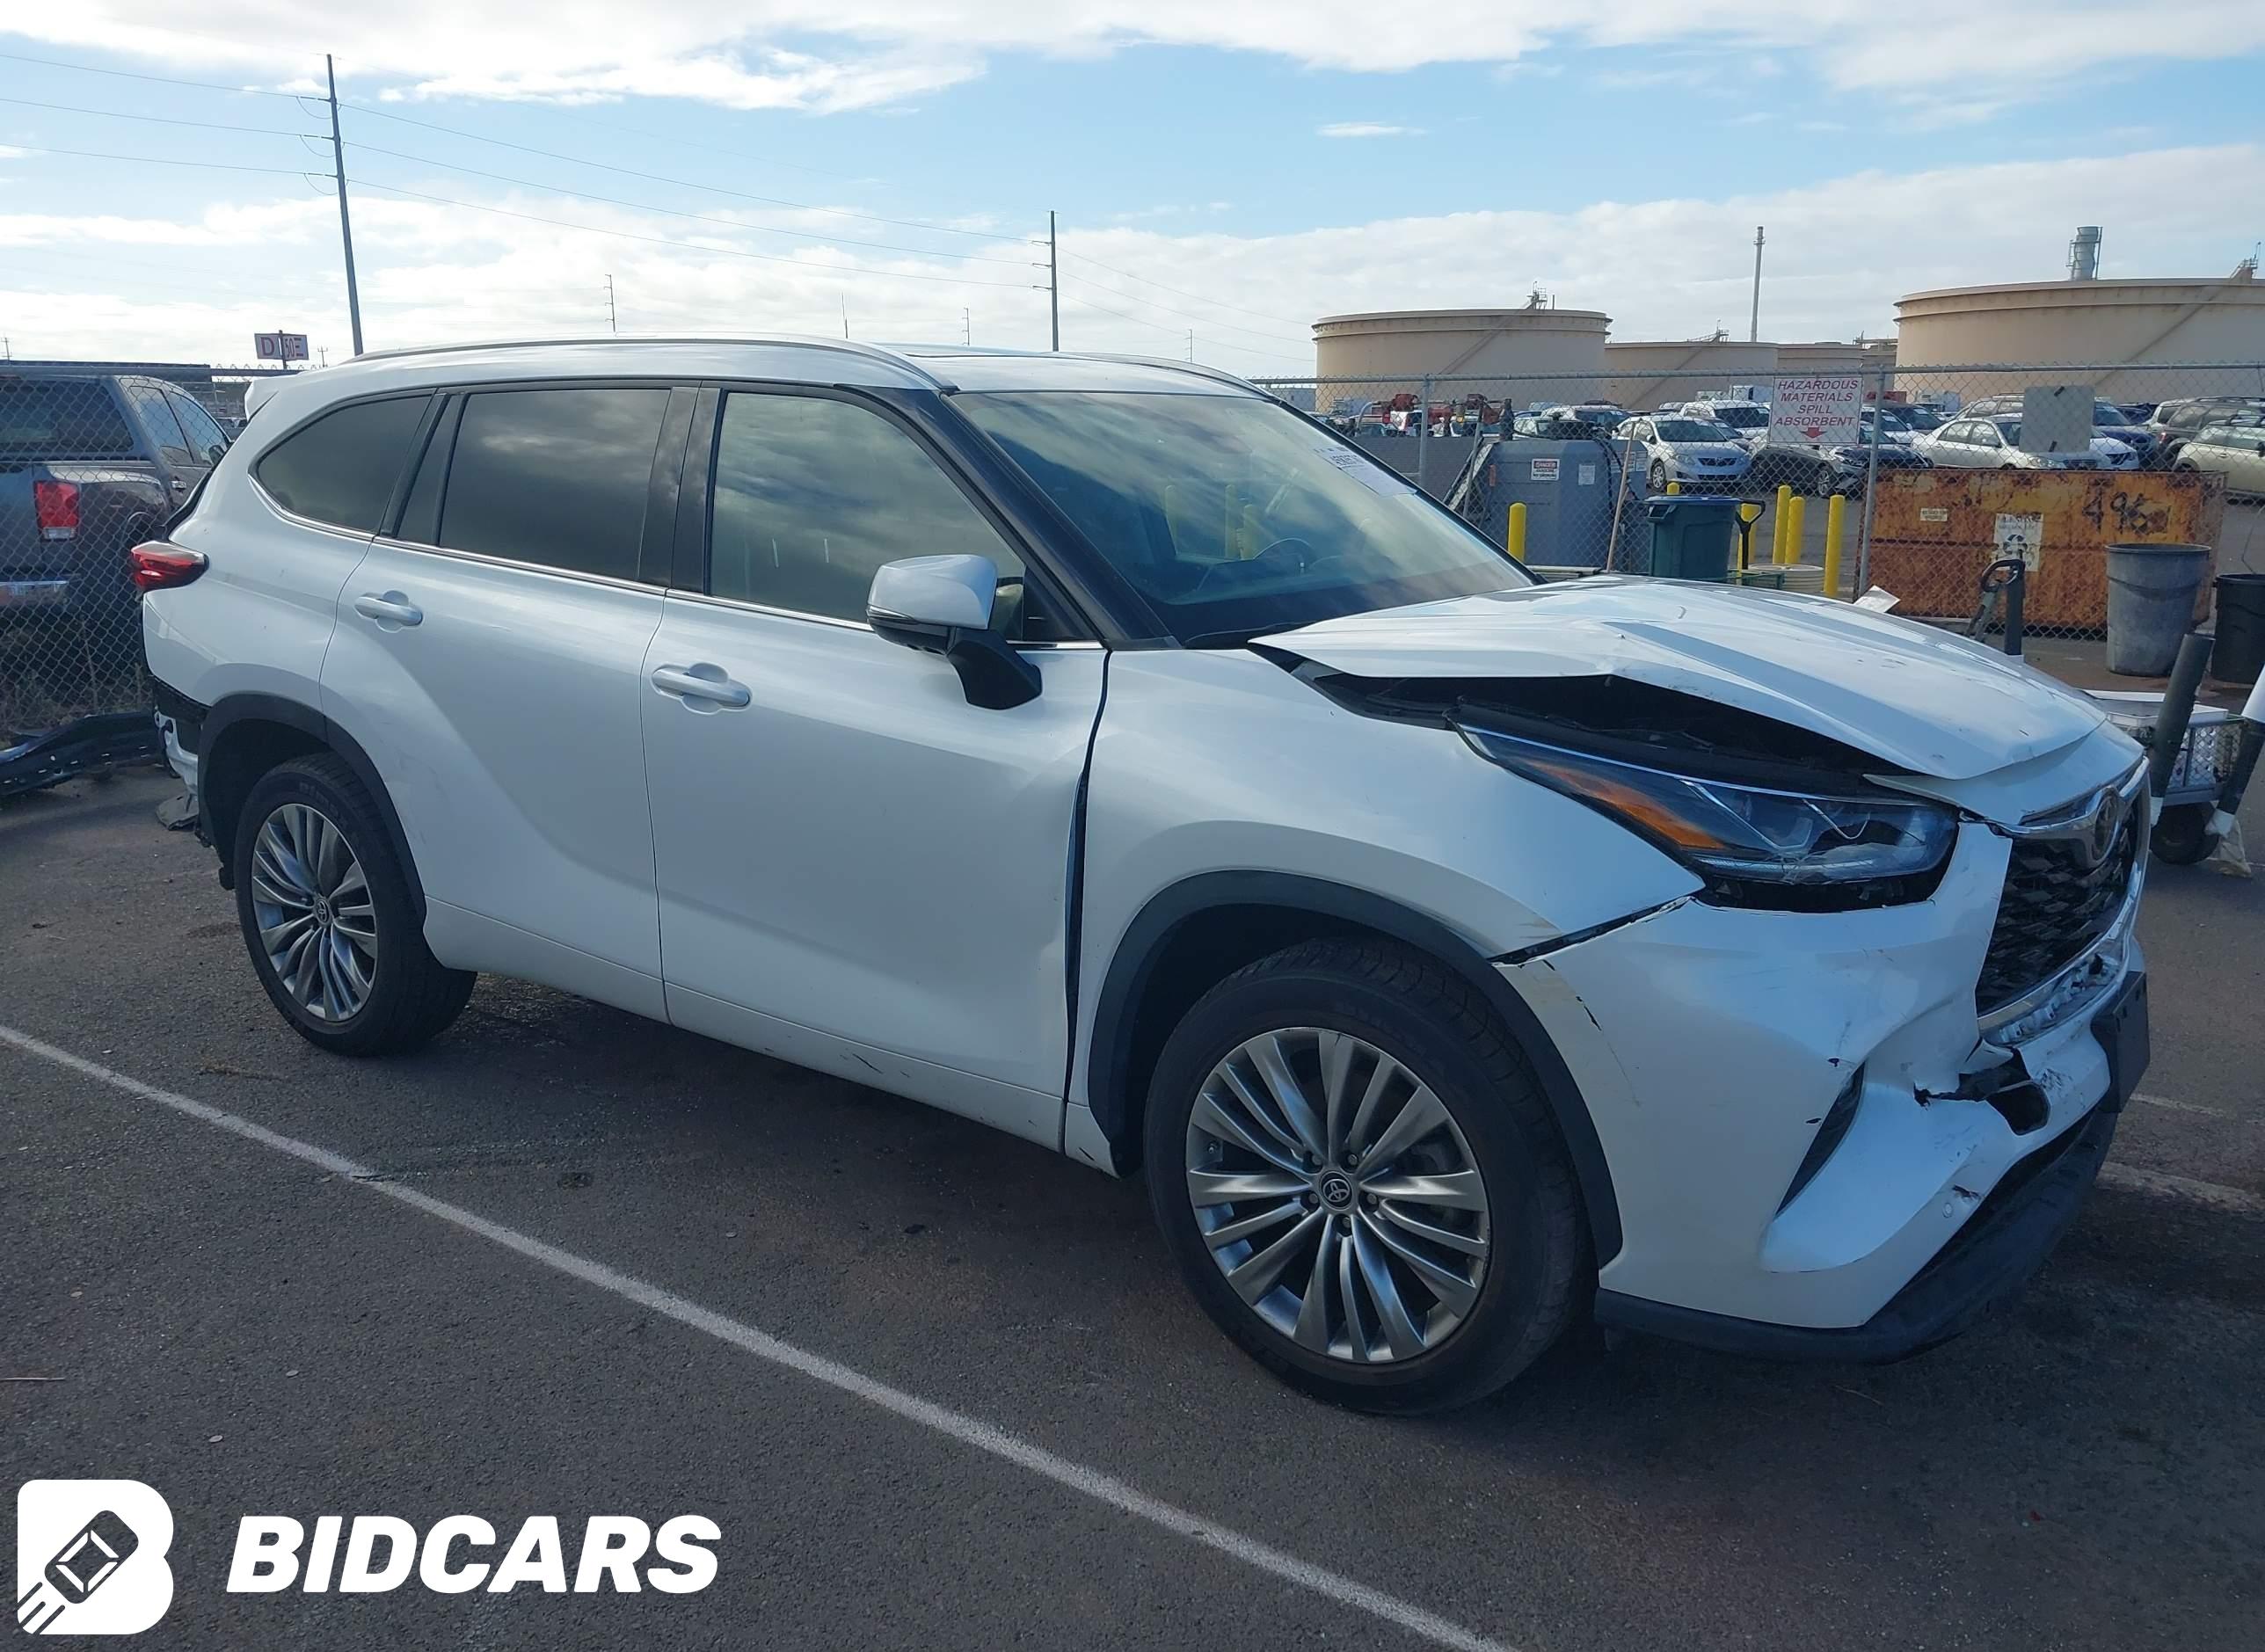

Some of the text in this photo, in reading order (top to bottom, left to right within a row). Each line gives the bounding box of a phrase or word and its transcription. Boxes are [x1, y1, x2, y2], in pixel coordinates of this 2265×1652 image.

[1778, 380, 1858, 389] HAZARDOUS
[1781, 392, 1854, 402] MATERIALS
[1797, 404, 1833, 414] SPILL
[1774, 417, 1855, 426] ABSORBENT
